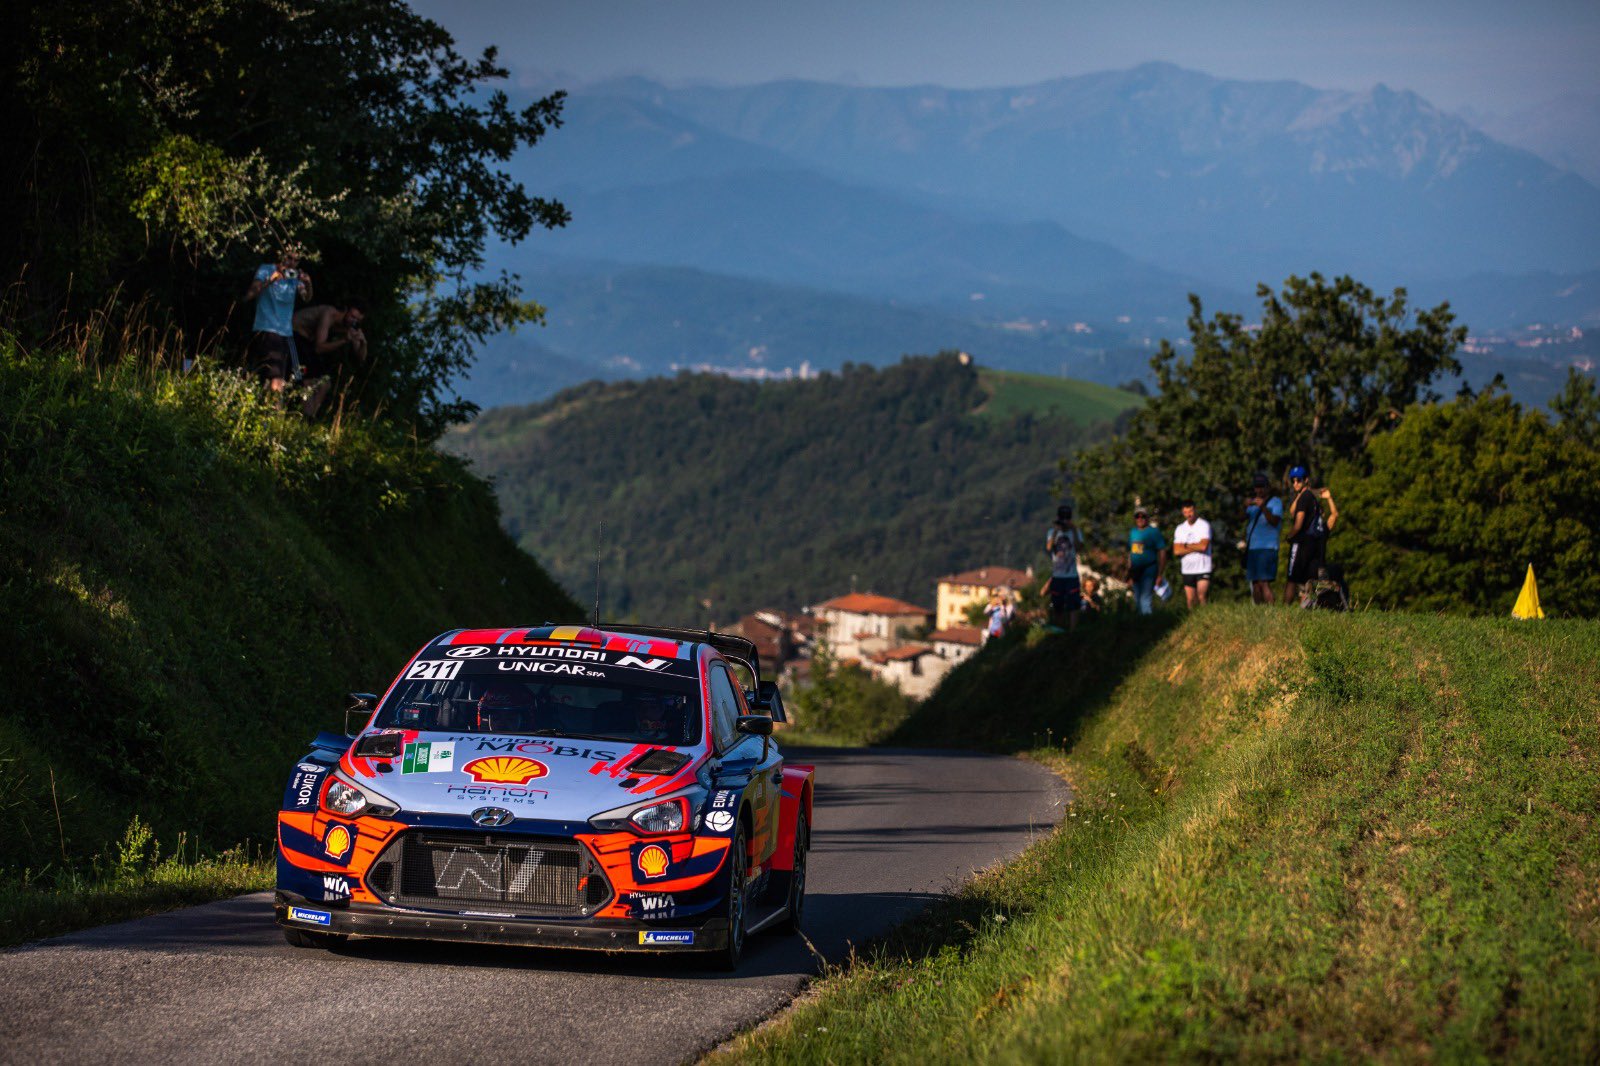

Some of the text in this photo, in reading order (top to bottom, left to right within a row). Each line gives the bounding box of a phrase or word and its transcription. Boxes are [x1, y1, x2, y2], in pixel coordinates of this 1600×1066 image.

[497, 646, 607, 662] HYUNDAI
[409, 660, 458, 679] 211
[498, 661, 586, 676] UNICAR
[475, 741, 617, 761] MOBIS
[296, 773, 318, 806] EUKOR
[457, 795, 536, 804] SYSTEMS
[297, 912, 327, 922] MICHELIN
